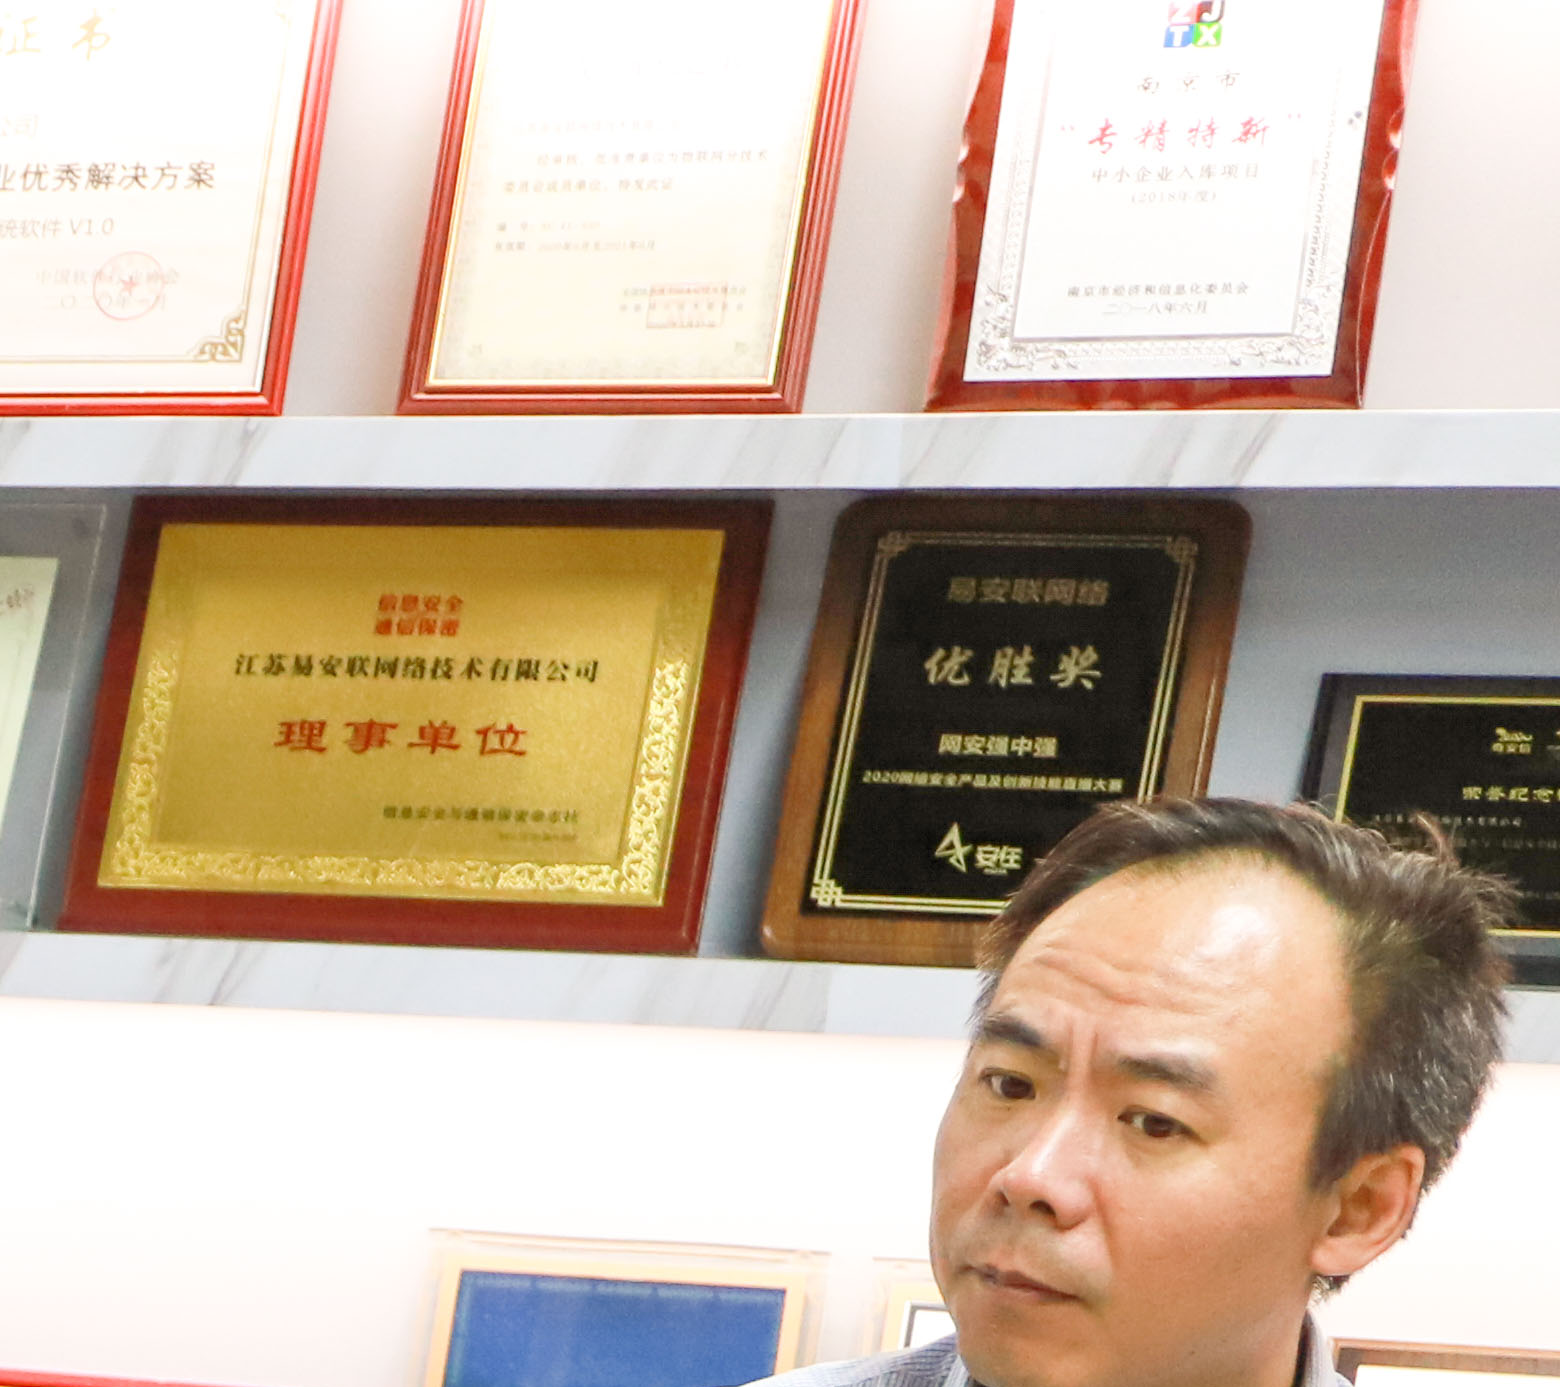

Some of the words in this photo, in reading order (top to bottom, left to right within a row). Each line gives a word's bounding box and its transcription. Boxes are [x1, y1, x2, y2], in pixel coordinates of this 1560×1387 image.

[1137, 69, 1241, 94] 南京市
[1091, 162, 1260, 184] 中小企业入库项目
[947, 576, 1111, 607] 易安联网络
[234, 653, 600, 684] 江苏易安联网络技术有限公司
[923, 643, 1103, 691] 优胜奖
[273, 718, 529, 757] 理事单位
[937, 733, 1059, 759] 网安强中强
